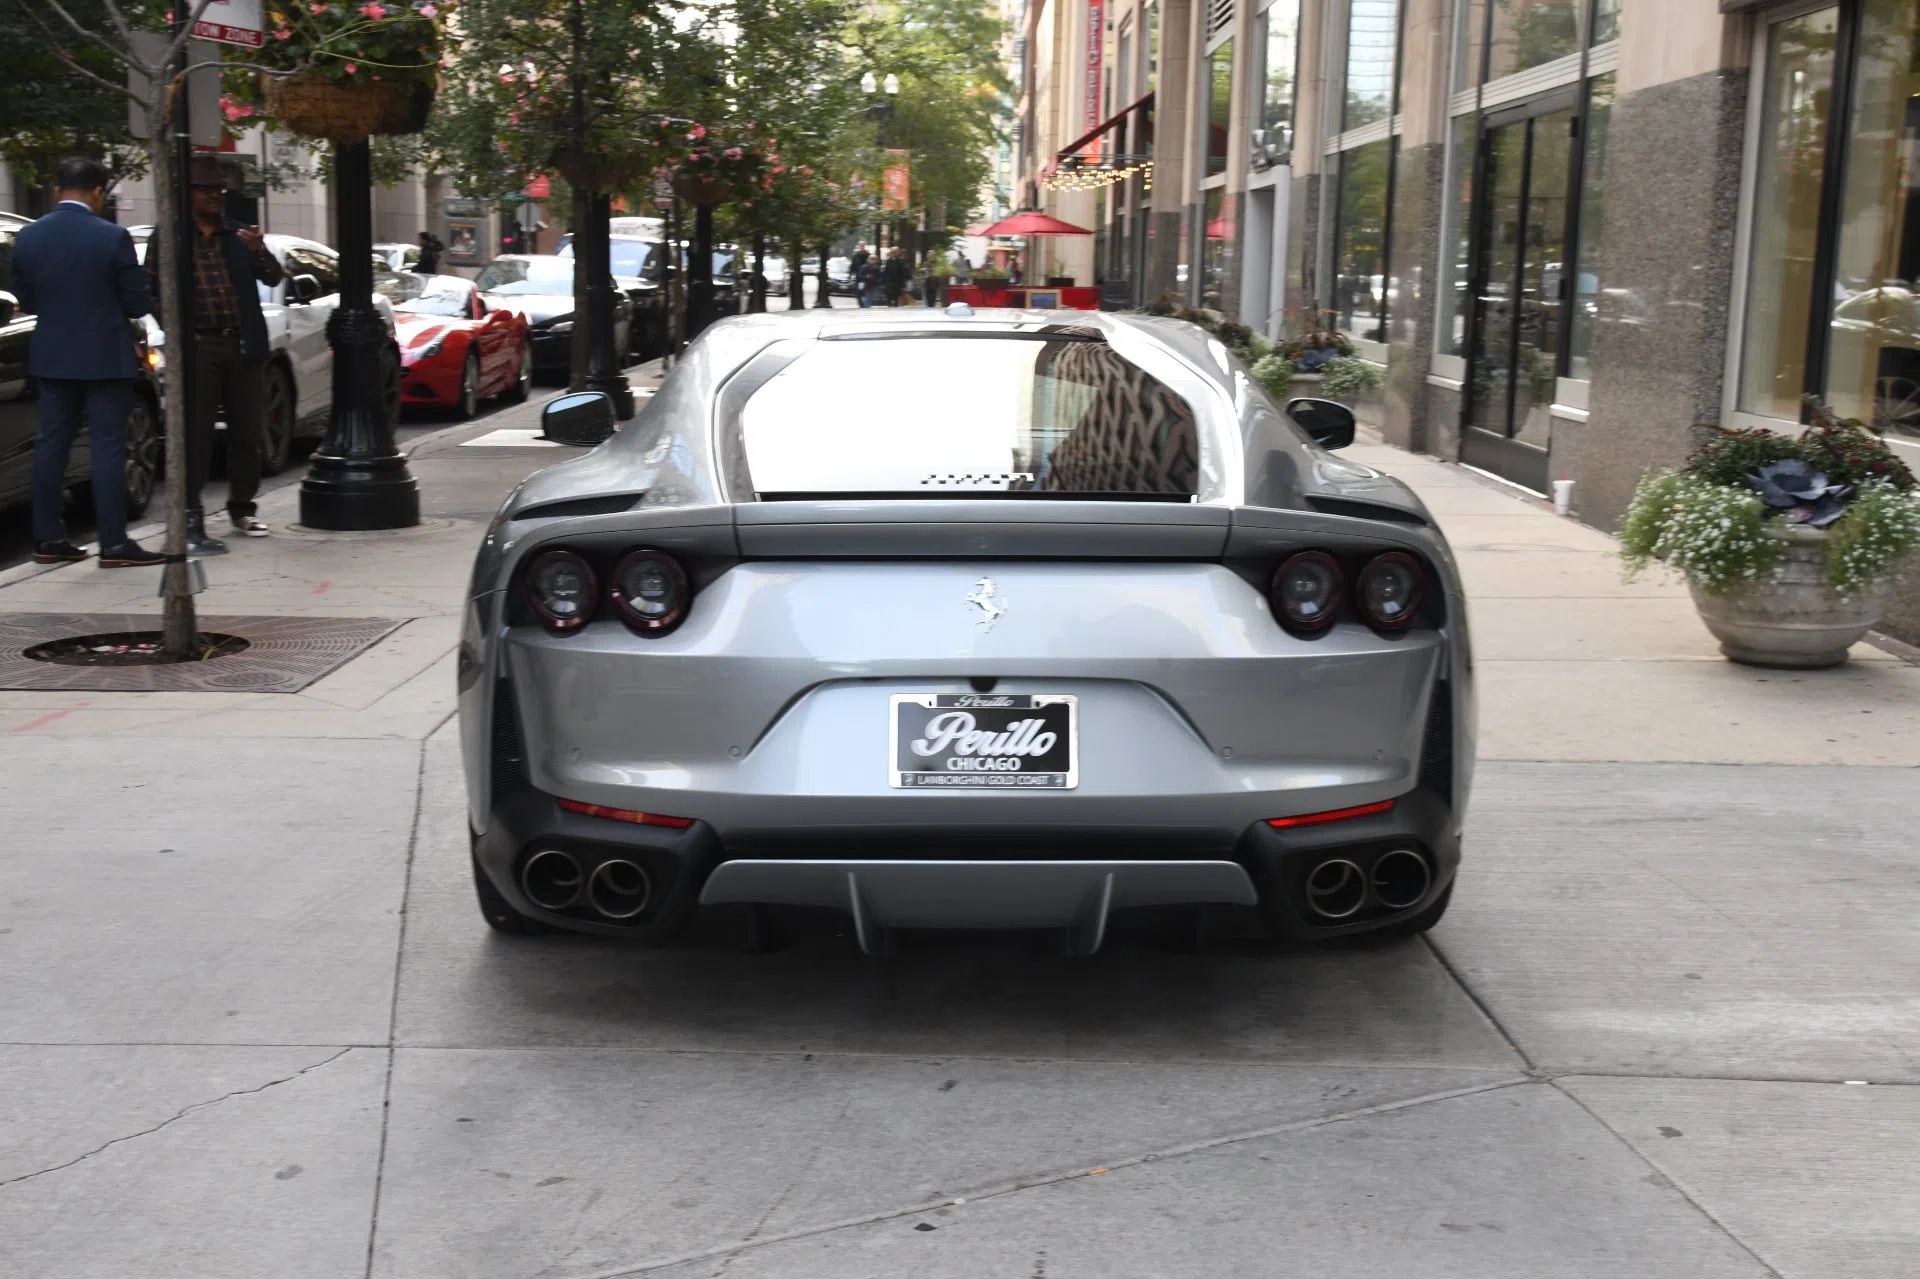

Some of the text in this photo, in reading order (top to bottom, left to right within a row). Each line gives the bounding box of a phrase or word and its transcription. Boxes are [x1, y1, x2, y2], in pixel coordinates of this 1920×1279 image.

[224, 28, 257, 44] ZONE
[954, 695, 1014, 706] Perillo
[911, 711, 1057, 756] Perillo
[946, 757, 1021, 771] CHICAGO
[918, 775, 1049, 785] LAMBORGHINI GOLD COAST
